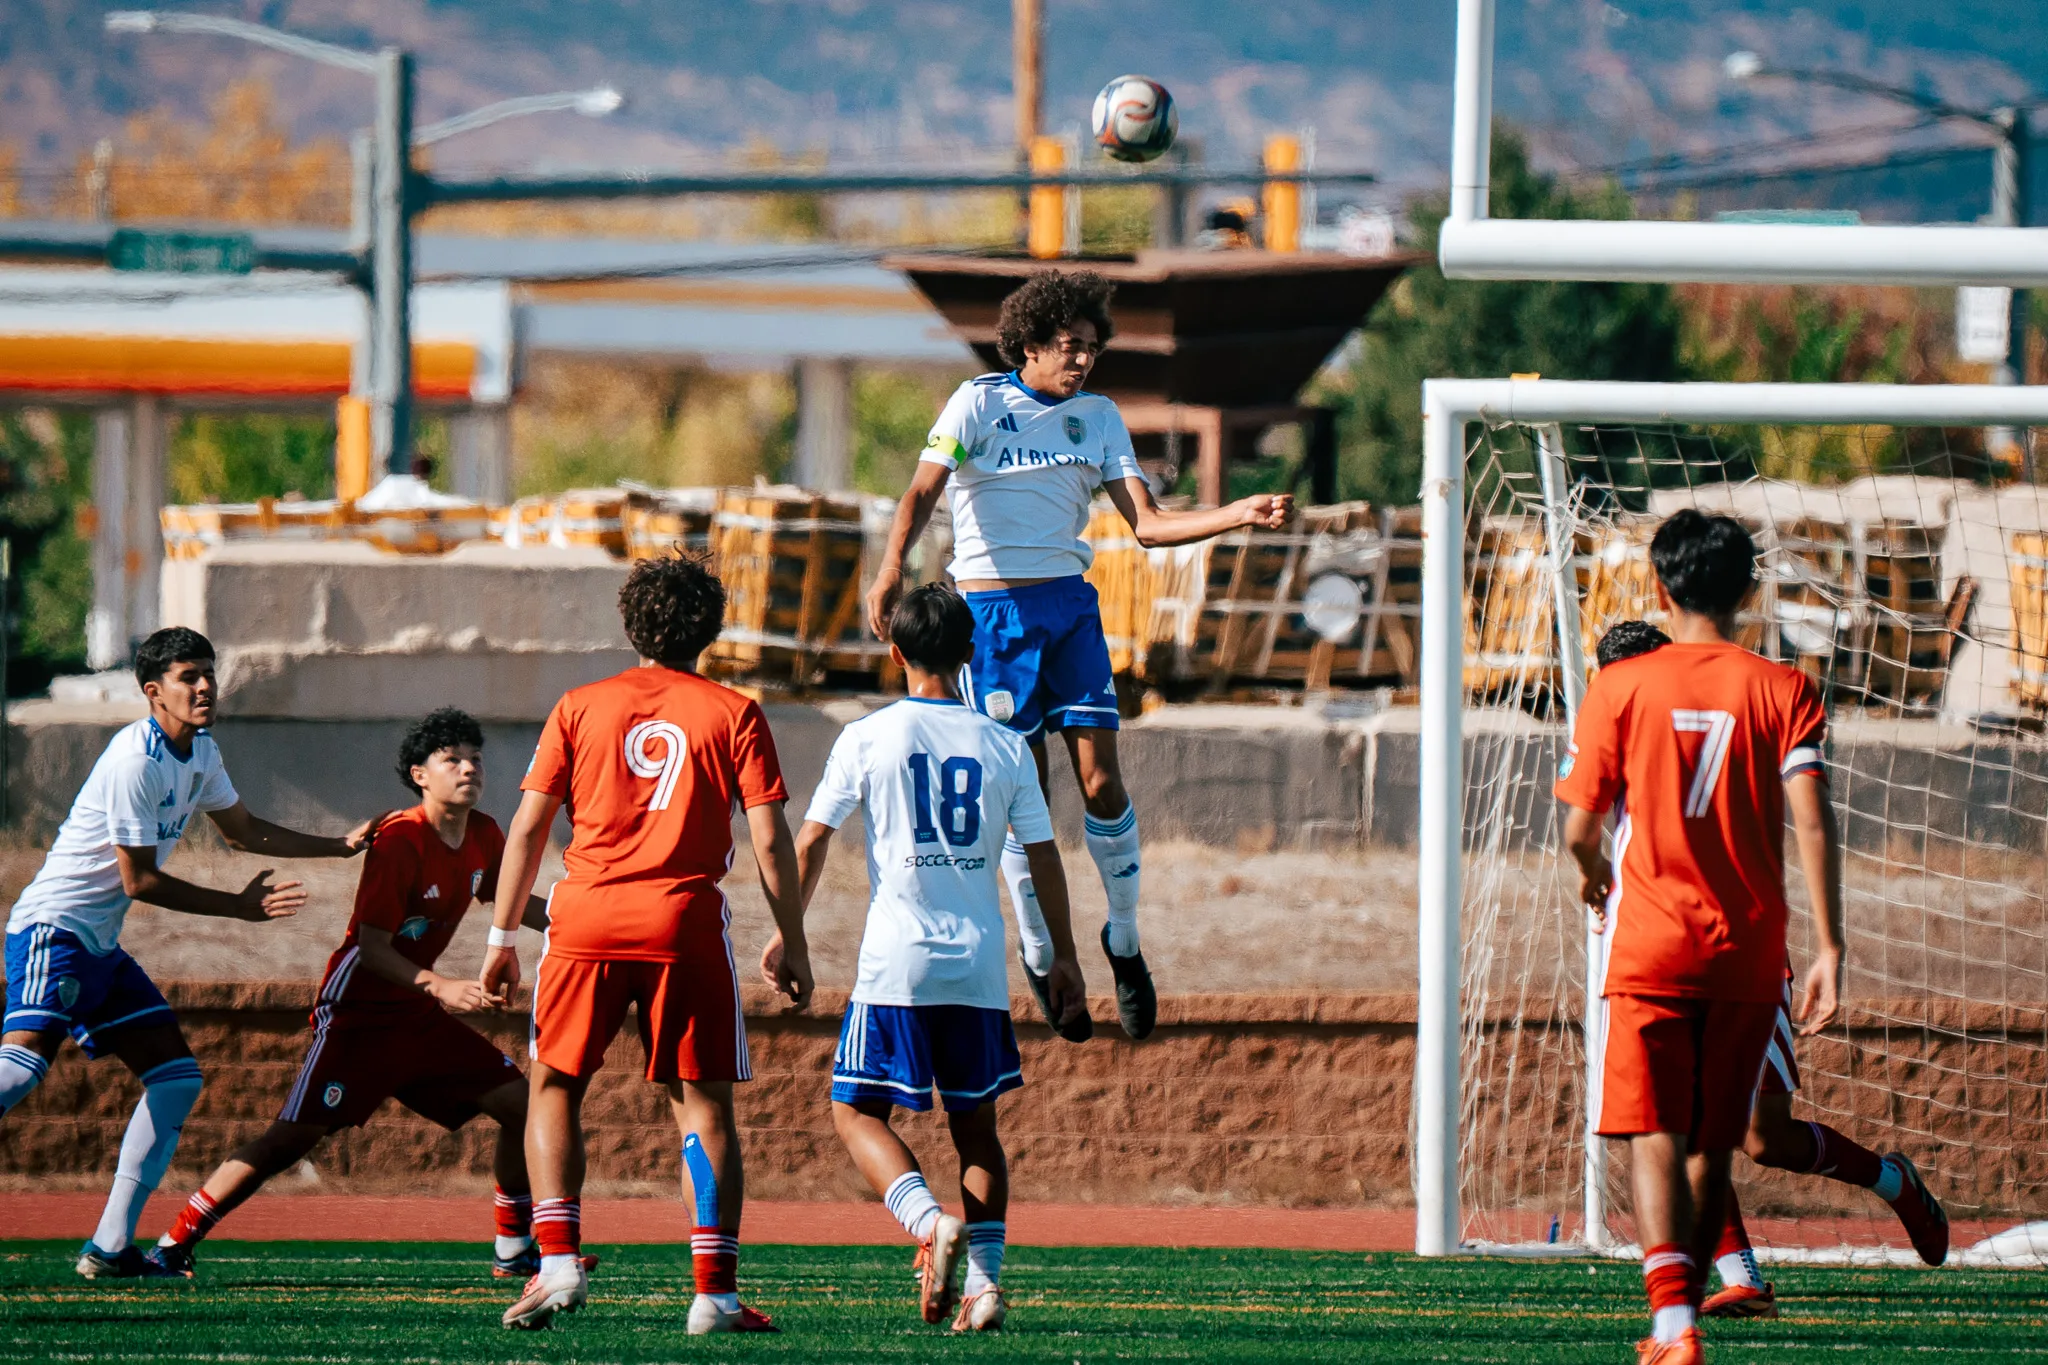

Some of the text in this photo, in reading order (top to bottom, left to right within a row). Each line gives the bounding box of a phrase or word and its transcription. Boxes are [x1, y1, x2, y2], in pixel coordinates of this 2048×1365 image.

[624, 720, 687, 811] 9
[909, 753, 982, 848] 18
[1671, 708, 1736, 818] 7
